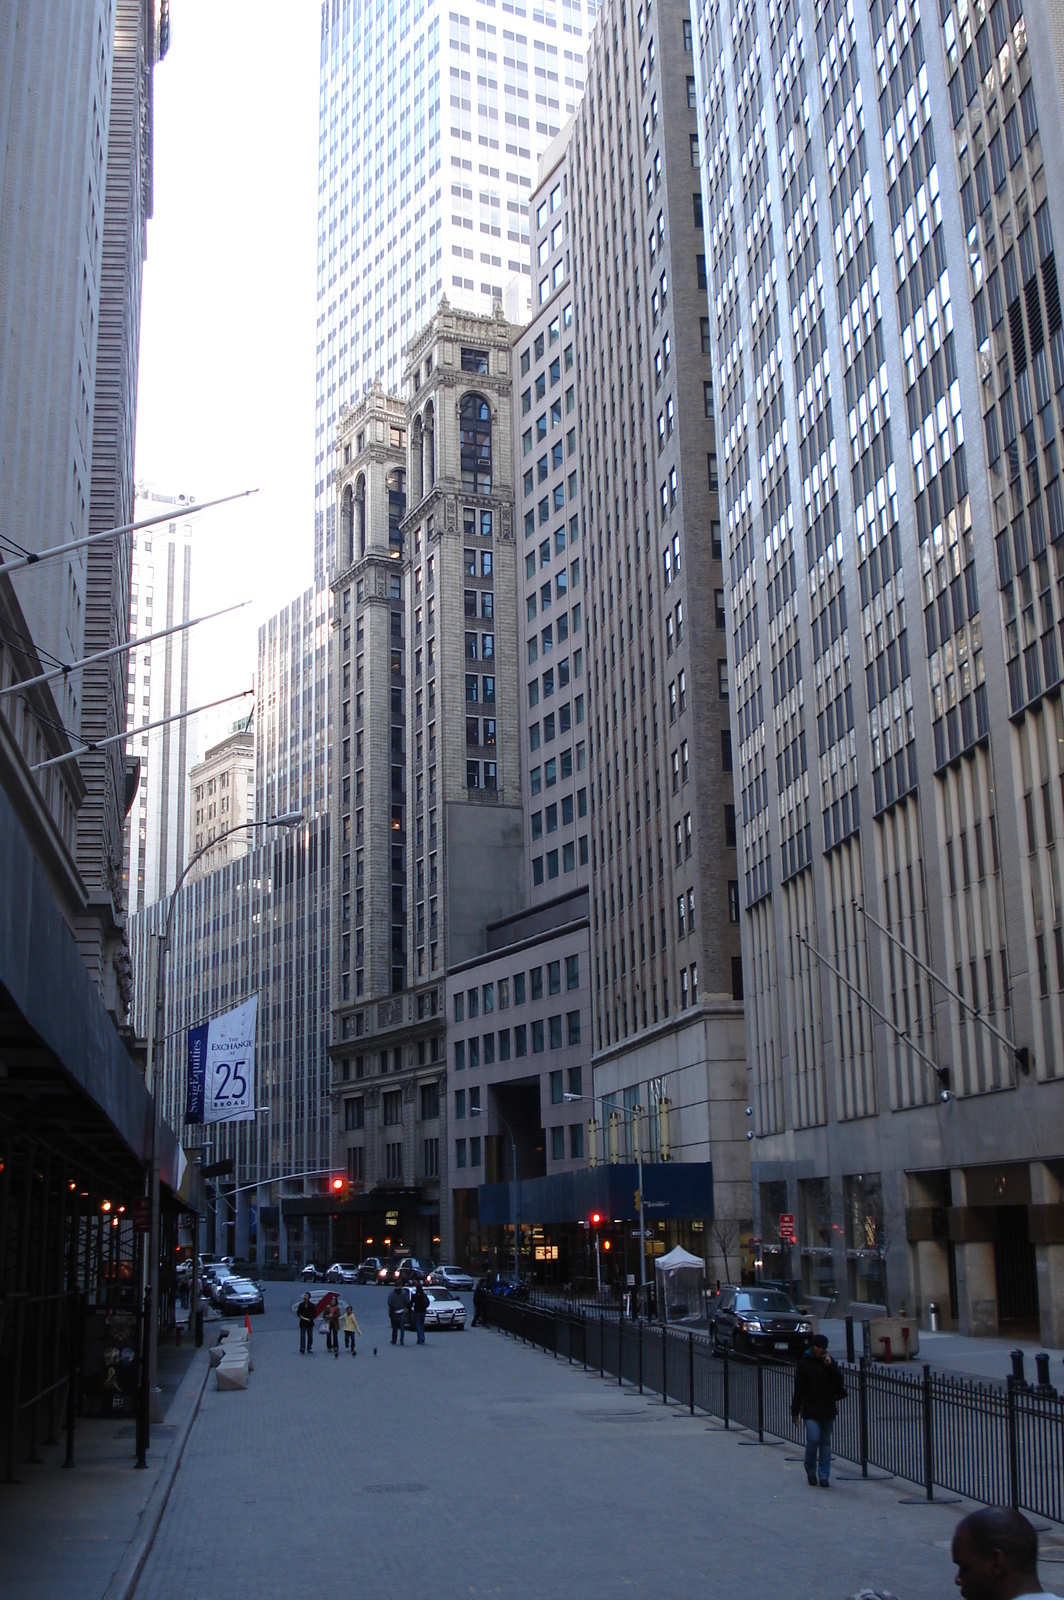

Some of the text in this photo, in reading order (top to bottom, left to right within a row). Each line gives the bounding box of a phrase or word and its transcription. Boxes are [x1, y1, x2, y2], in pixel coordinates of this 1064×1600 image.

[211, 1040, 253, 1050] EXCHANGE
[188, 1039, 203, 1112] SwigEquities
[214, 1061, 246, 1100] 25
